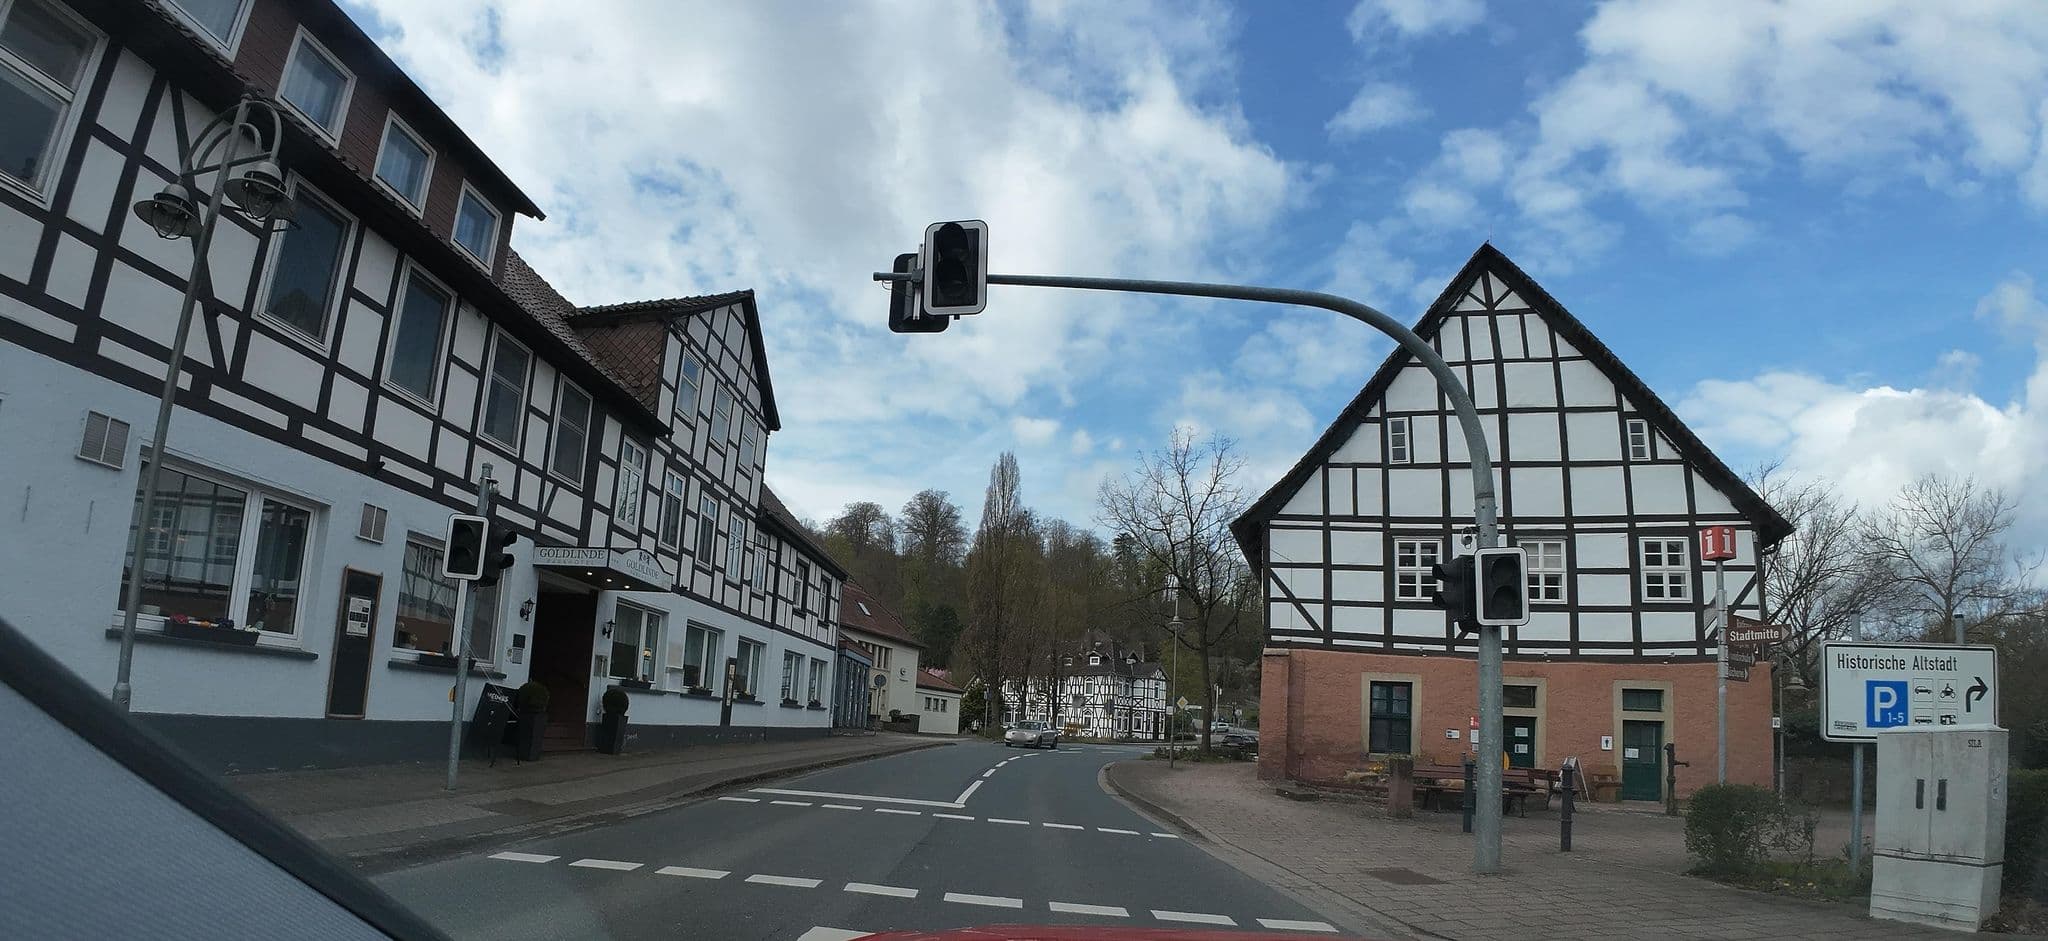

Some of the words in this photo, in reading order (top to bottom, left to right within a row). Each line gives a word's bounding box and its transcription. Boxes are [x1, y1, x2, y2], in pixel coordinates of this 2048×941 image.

[540, 548, 605, 560] GOLDLINDE
[1729, 628, 1780, 642] Stadtmitte
[1837, 653, 1906, 671] Historische
[1912, 655, 1958, 672] Altstadt
[1873, 686, 1898, 723] P
[1887, 712, 1905, 724] 1-5
